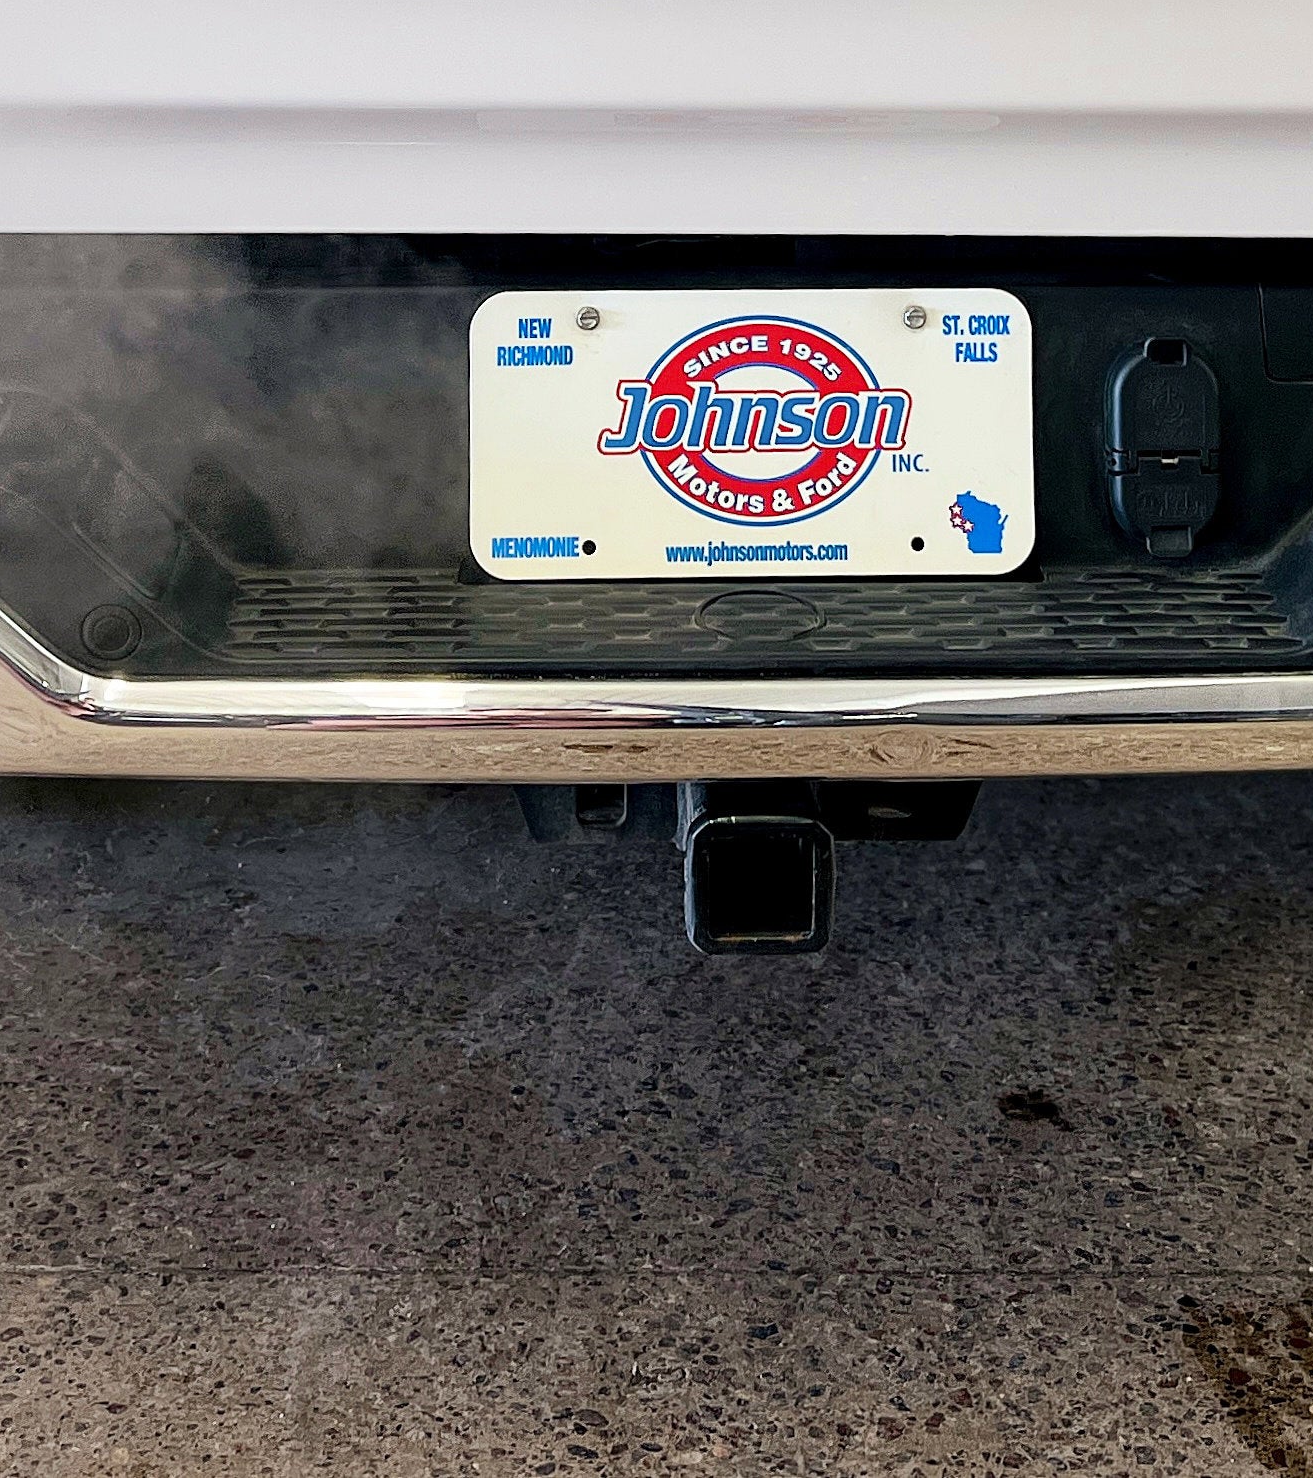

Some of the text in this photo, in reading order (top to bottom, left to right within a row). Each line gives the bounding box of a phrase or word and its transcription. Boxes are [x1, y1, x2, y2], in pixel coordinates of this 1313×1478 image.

[518, 317, 552, 339] NEW
[942, 315, 1010, 336] ST. CROIX
[497, 345, 573, 367] RICHMOND
[683, 335, 843, 382] SINCE 1925
[955, 341, 998, 363] FALLS
[601, 382, 910, 451] Johnson
[891, 453, 930, 472] INC.
[667, 452, 857, 515] Motors & Ford
[492, 536, 579, 559] MENOMONIE
[665, 541, 849, 566] www.johnsonmotors.com
